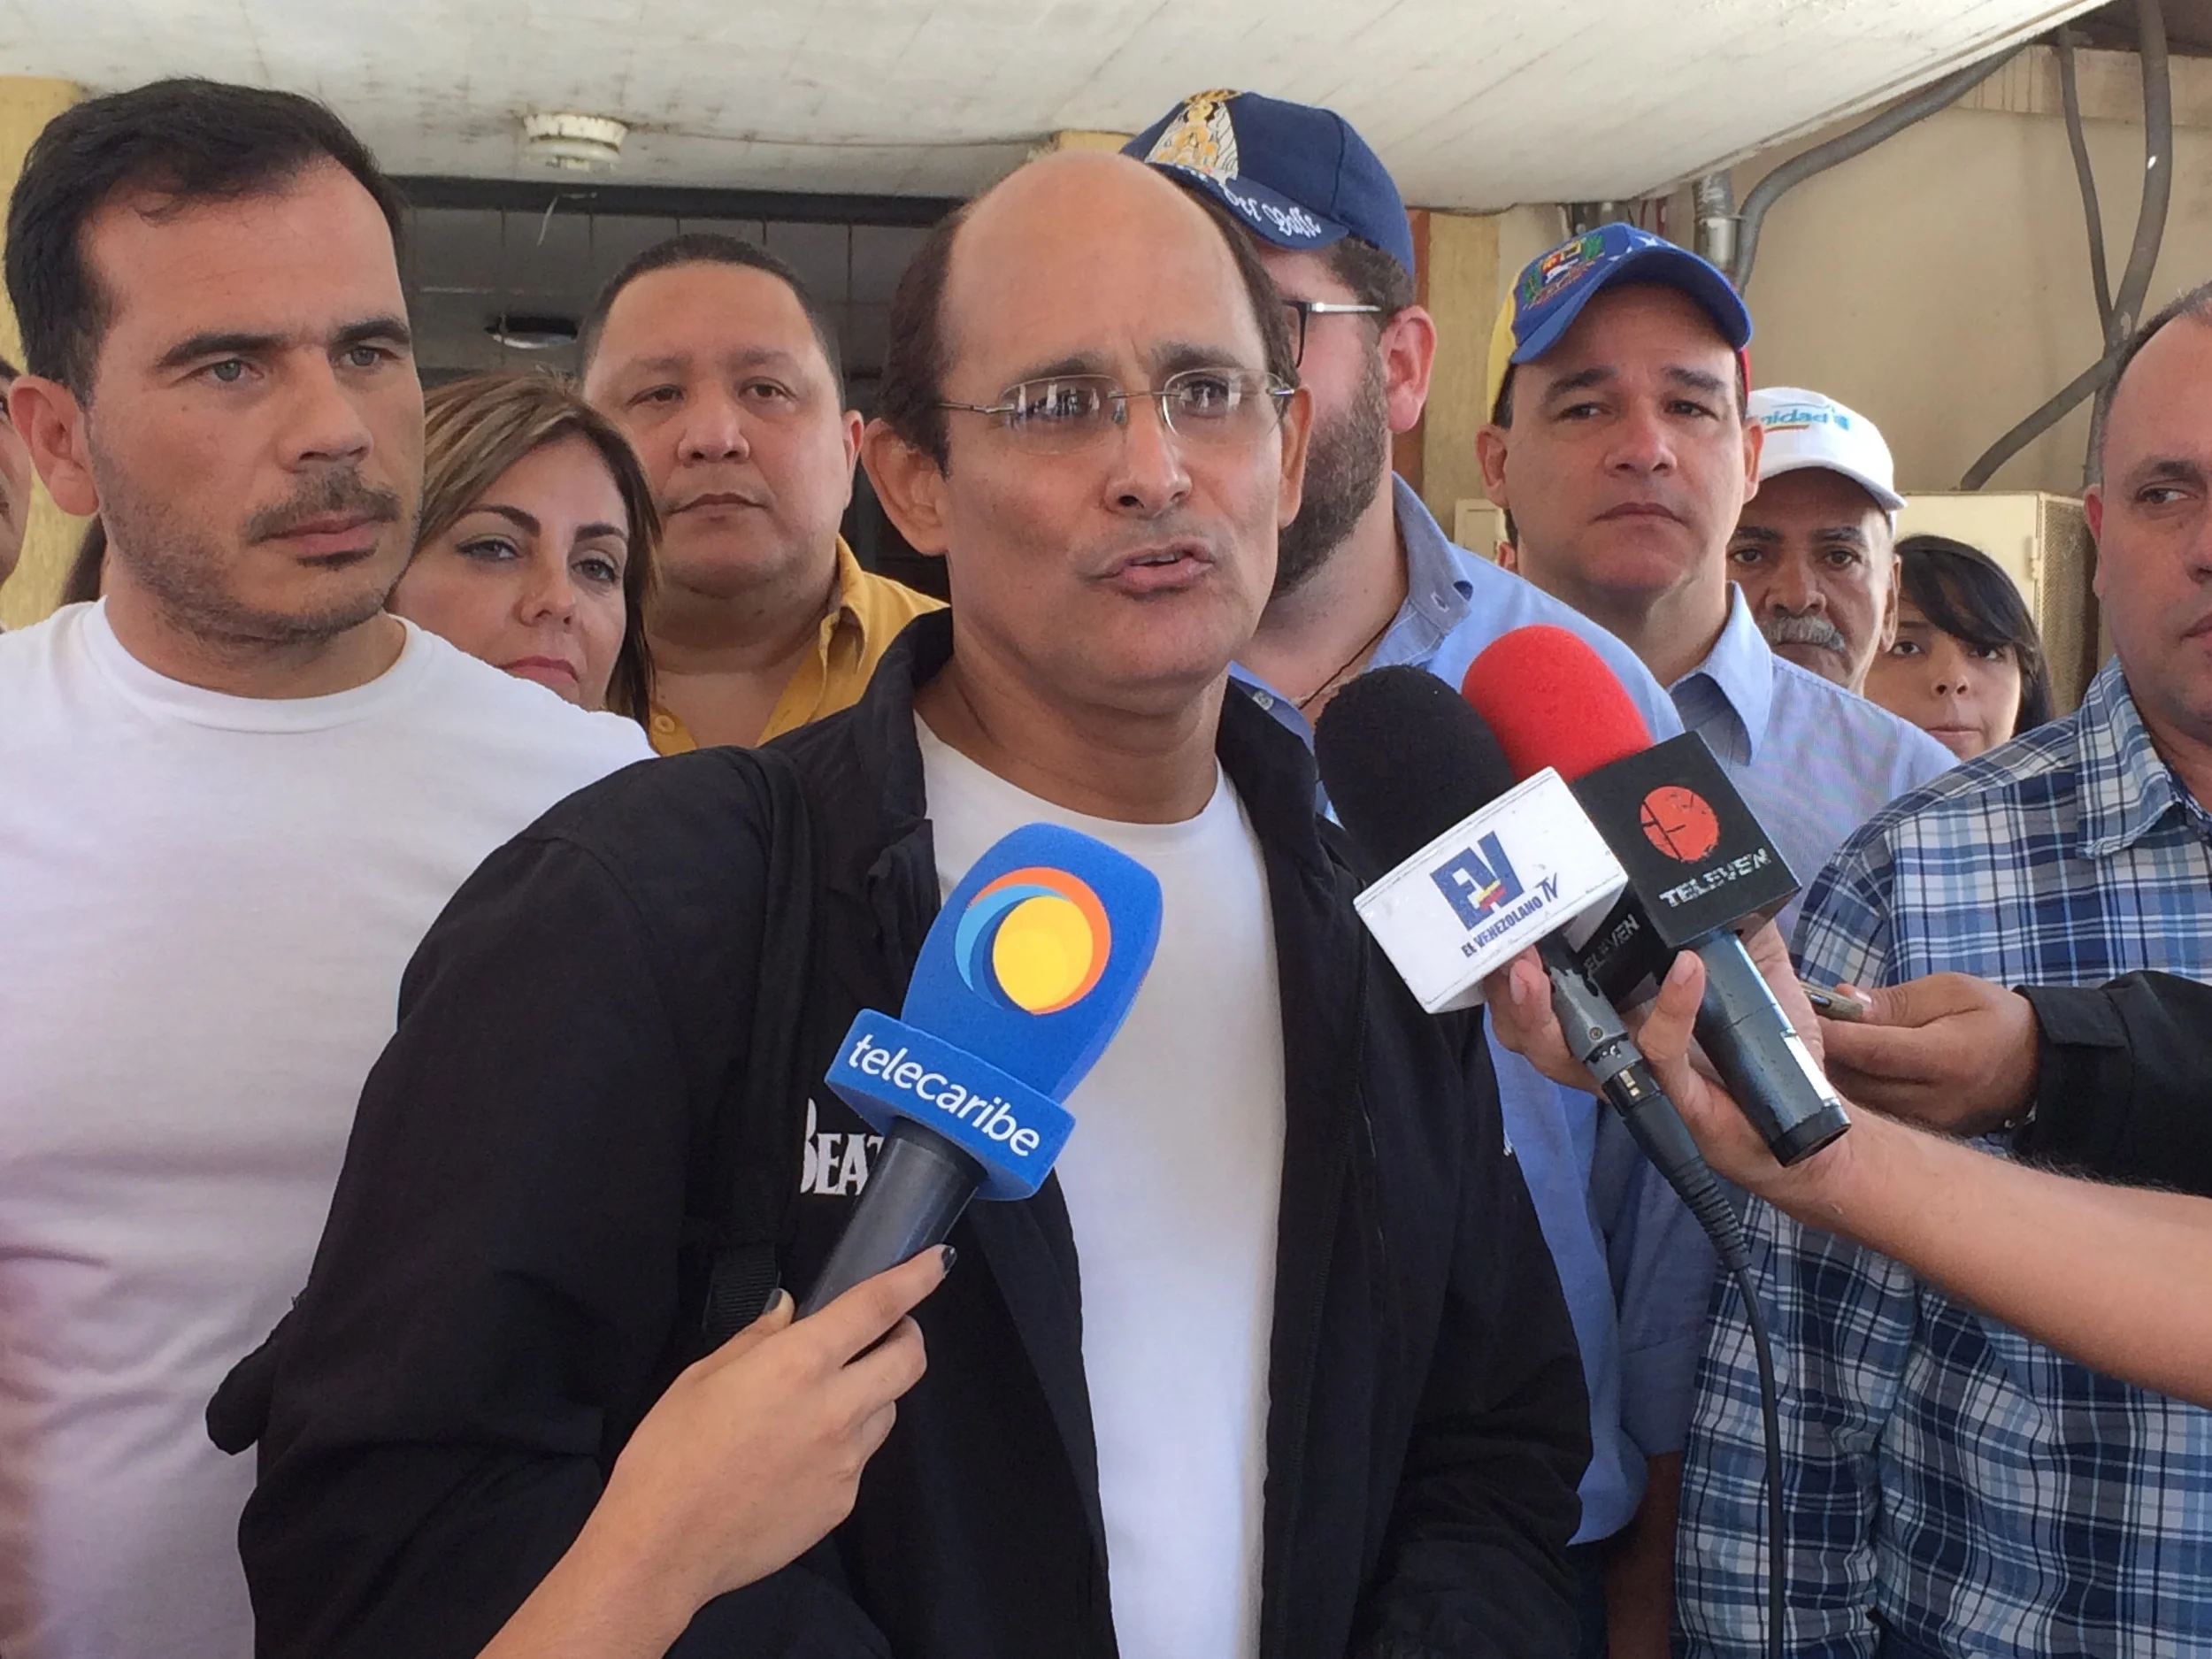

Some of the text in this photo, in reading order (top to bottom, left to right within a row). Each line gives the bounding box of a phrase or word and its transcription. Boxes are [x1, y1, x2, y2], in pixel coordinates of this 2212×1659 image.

[1761, 409, 1829, 426] nidad
[1658, 848, 1772, 908] TELEVEN
[1460, 872, 1559, 958] EL VENEZOLANO TV
[1582, 913, 1640, 973] ELEVEN
[849, 1033, 1041, 1157] telecaribe
